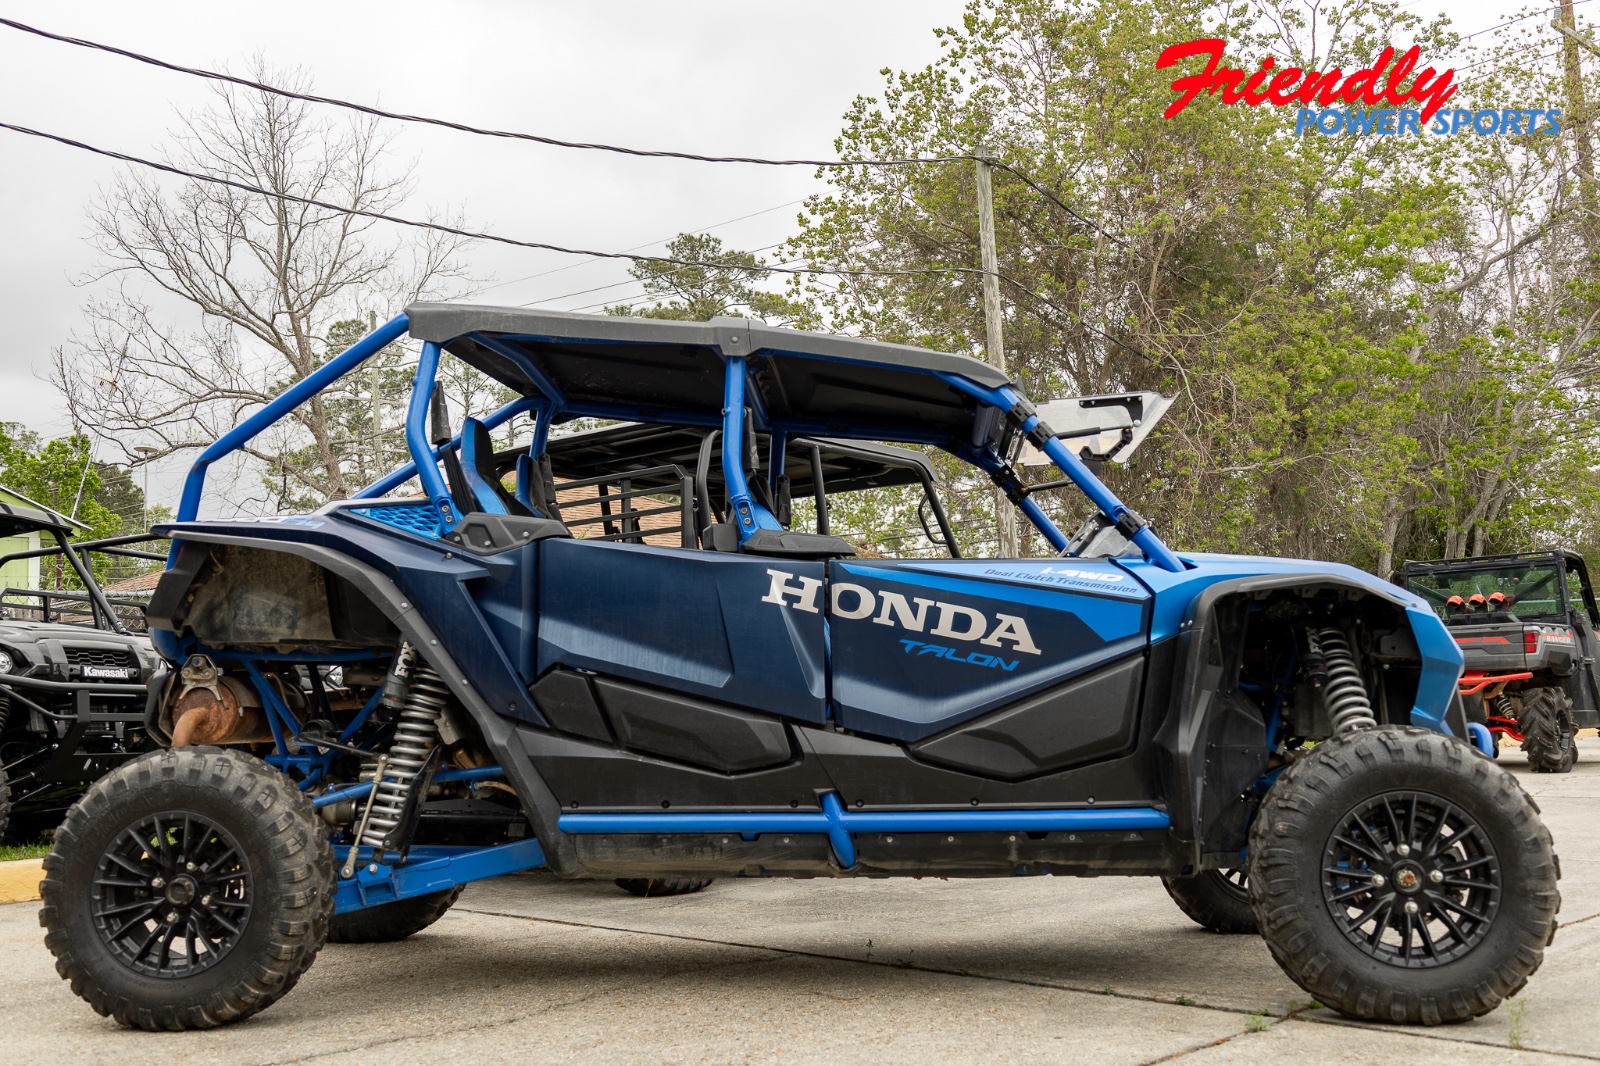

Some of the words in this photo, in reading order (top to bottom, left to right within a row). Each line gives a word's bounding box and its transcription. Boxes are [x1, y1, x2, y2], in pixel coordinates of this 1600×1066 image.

[984, 568, 1013, 578] Dual
[1017, 571, 1055, 582] Clutch
[1055, 576, 1138, 594] Transmission
[762, 568, 1042, 655] HONDA
[1546, 635, 1571, 644] RANGER
[394, 641, 417, 679] FOX
[899, 638, 1020, 671] TALON
[83, 666, 129, 679] Kawasaki
